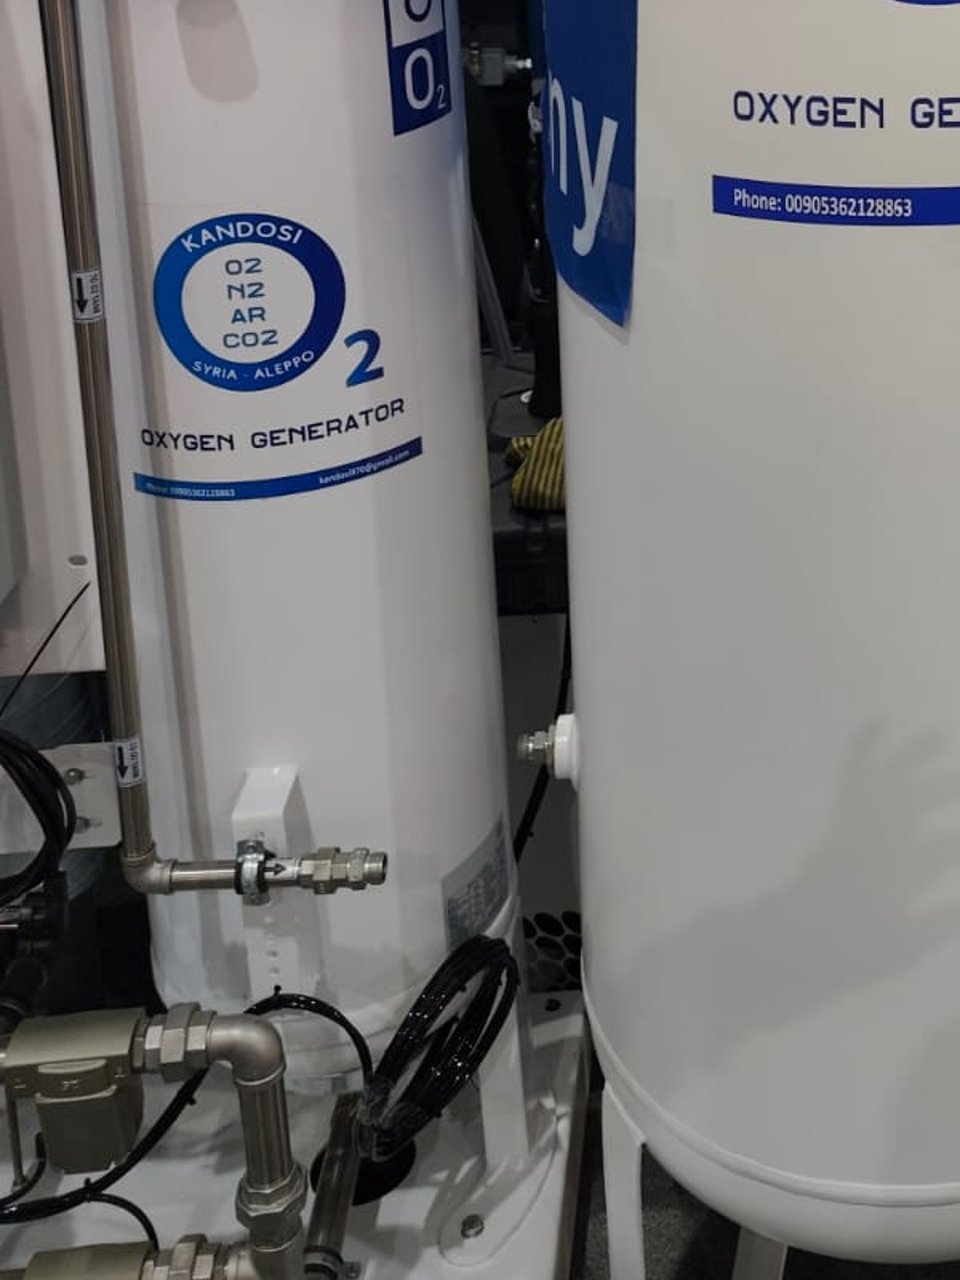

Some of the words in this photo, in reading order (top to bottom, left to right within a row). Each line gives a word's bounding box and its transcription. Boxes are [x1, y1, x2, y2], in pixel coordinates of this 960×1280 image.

[732, 90, 885, 129] OXYGEN
[733, 187, 782, 212] Phone:
[784, 193, 913, 218] 00905362128863
[180, 221, 304, 254] KANDOSI
[224, 257, 263, 276] O2
[226, 281, 266, 301] N2
[230, 306, 267, 325] AR
[222, 329, 279, 349] CO2
[191, 359, 239, 381] SYRIA
[253, 349, 315, 381] ALEPPO
[343, 328, 385, 388] 2
[140, 428, 235, 452] OXYGEN
[250, 397, 405, 450] GENERATOR
